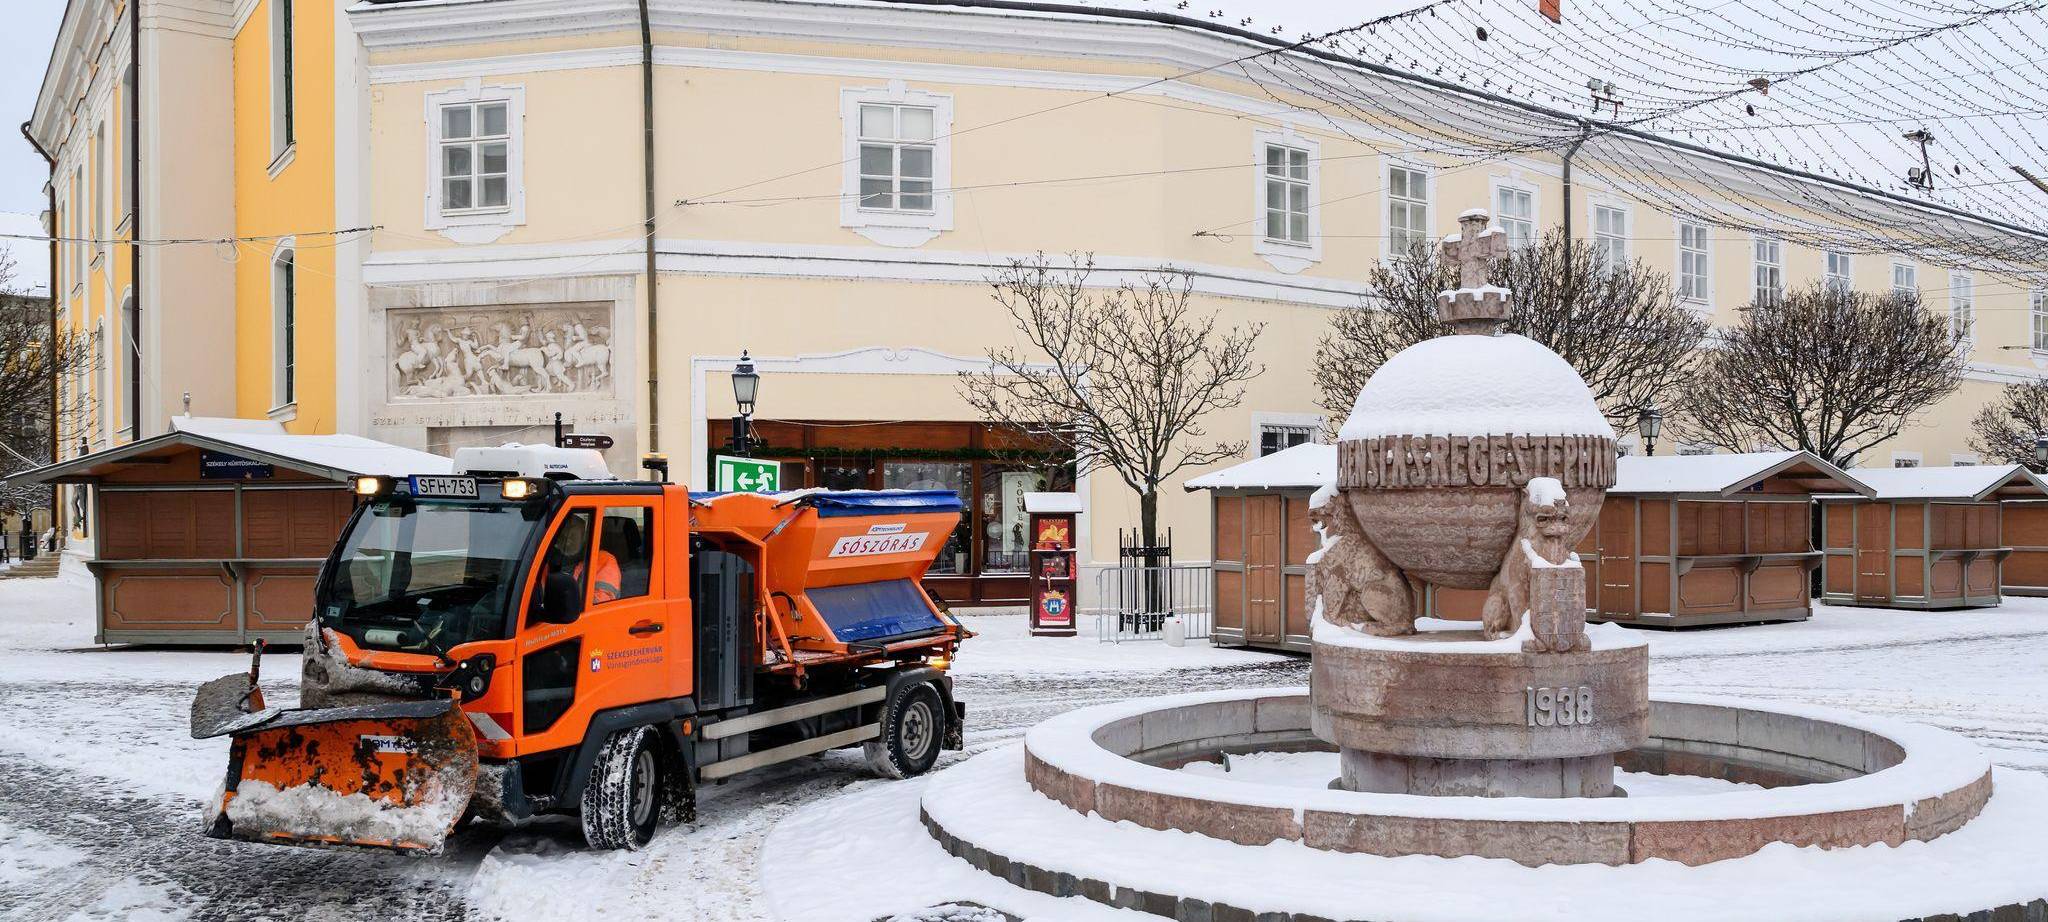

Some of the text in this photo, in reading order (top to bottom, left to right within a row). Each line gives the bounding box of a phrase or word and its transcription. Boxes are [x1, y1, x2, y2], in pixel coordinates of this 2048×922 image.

[419, 478, 475, 495] SFH-753
[839, 535, 919, 555] SÓSZÓRÁS
[1527, 686, 1593, 727] 1938
